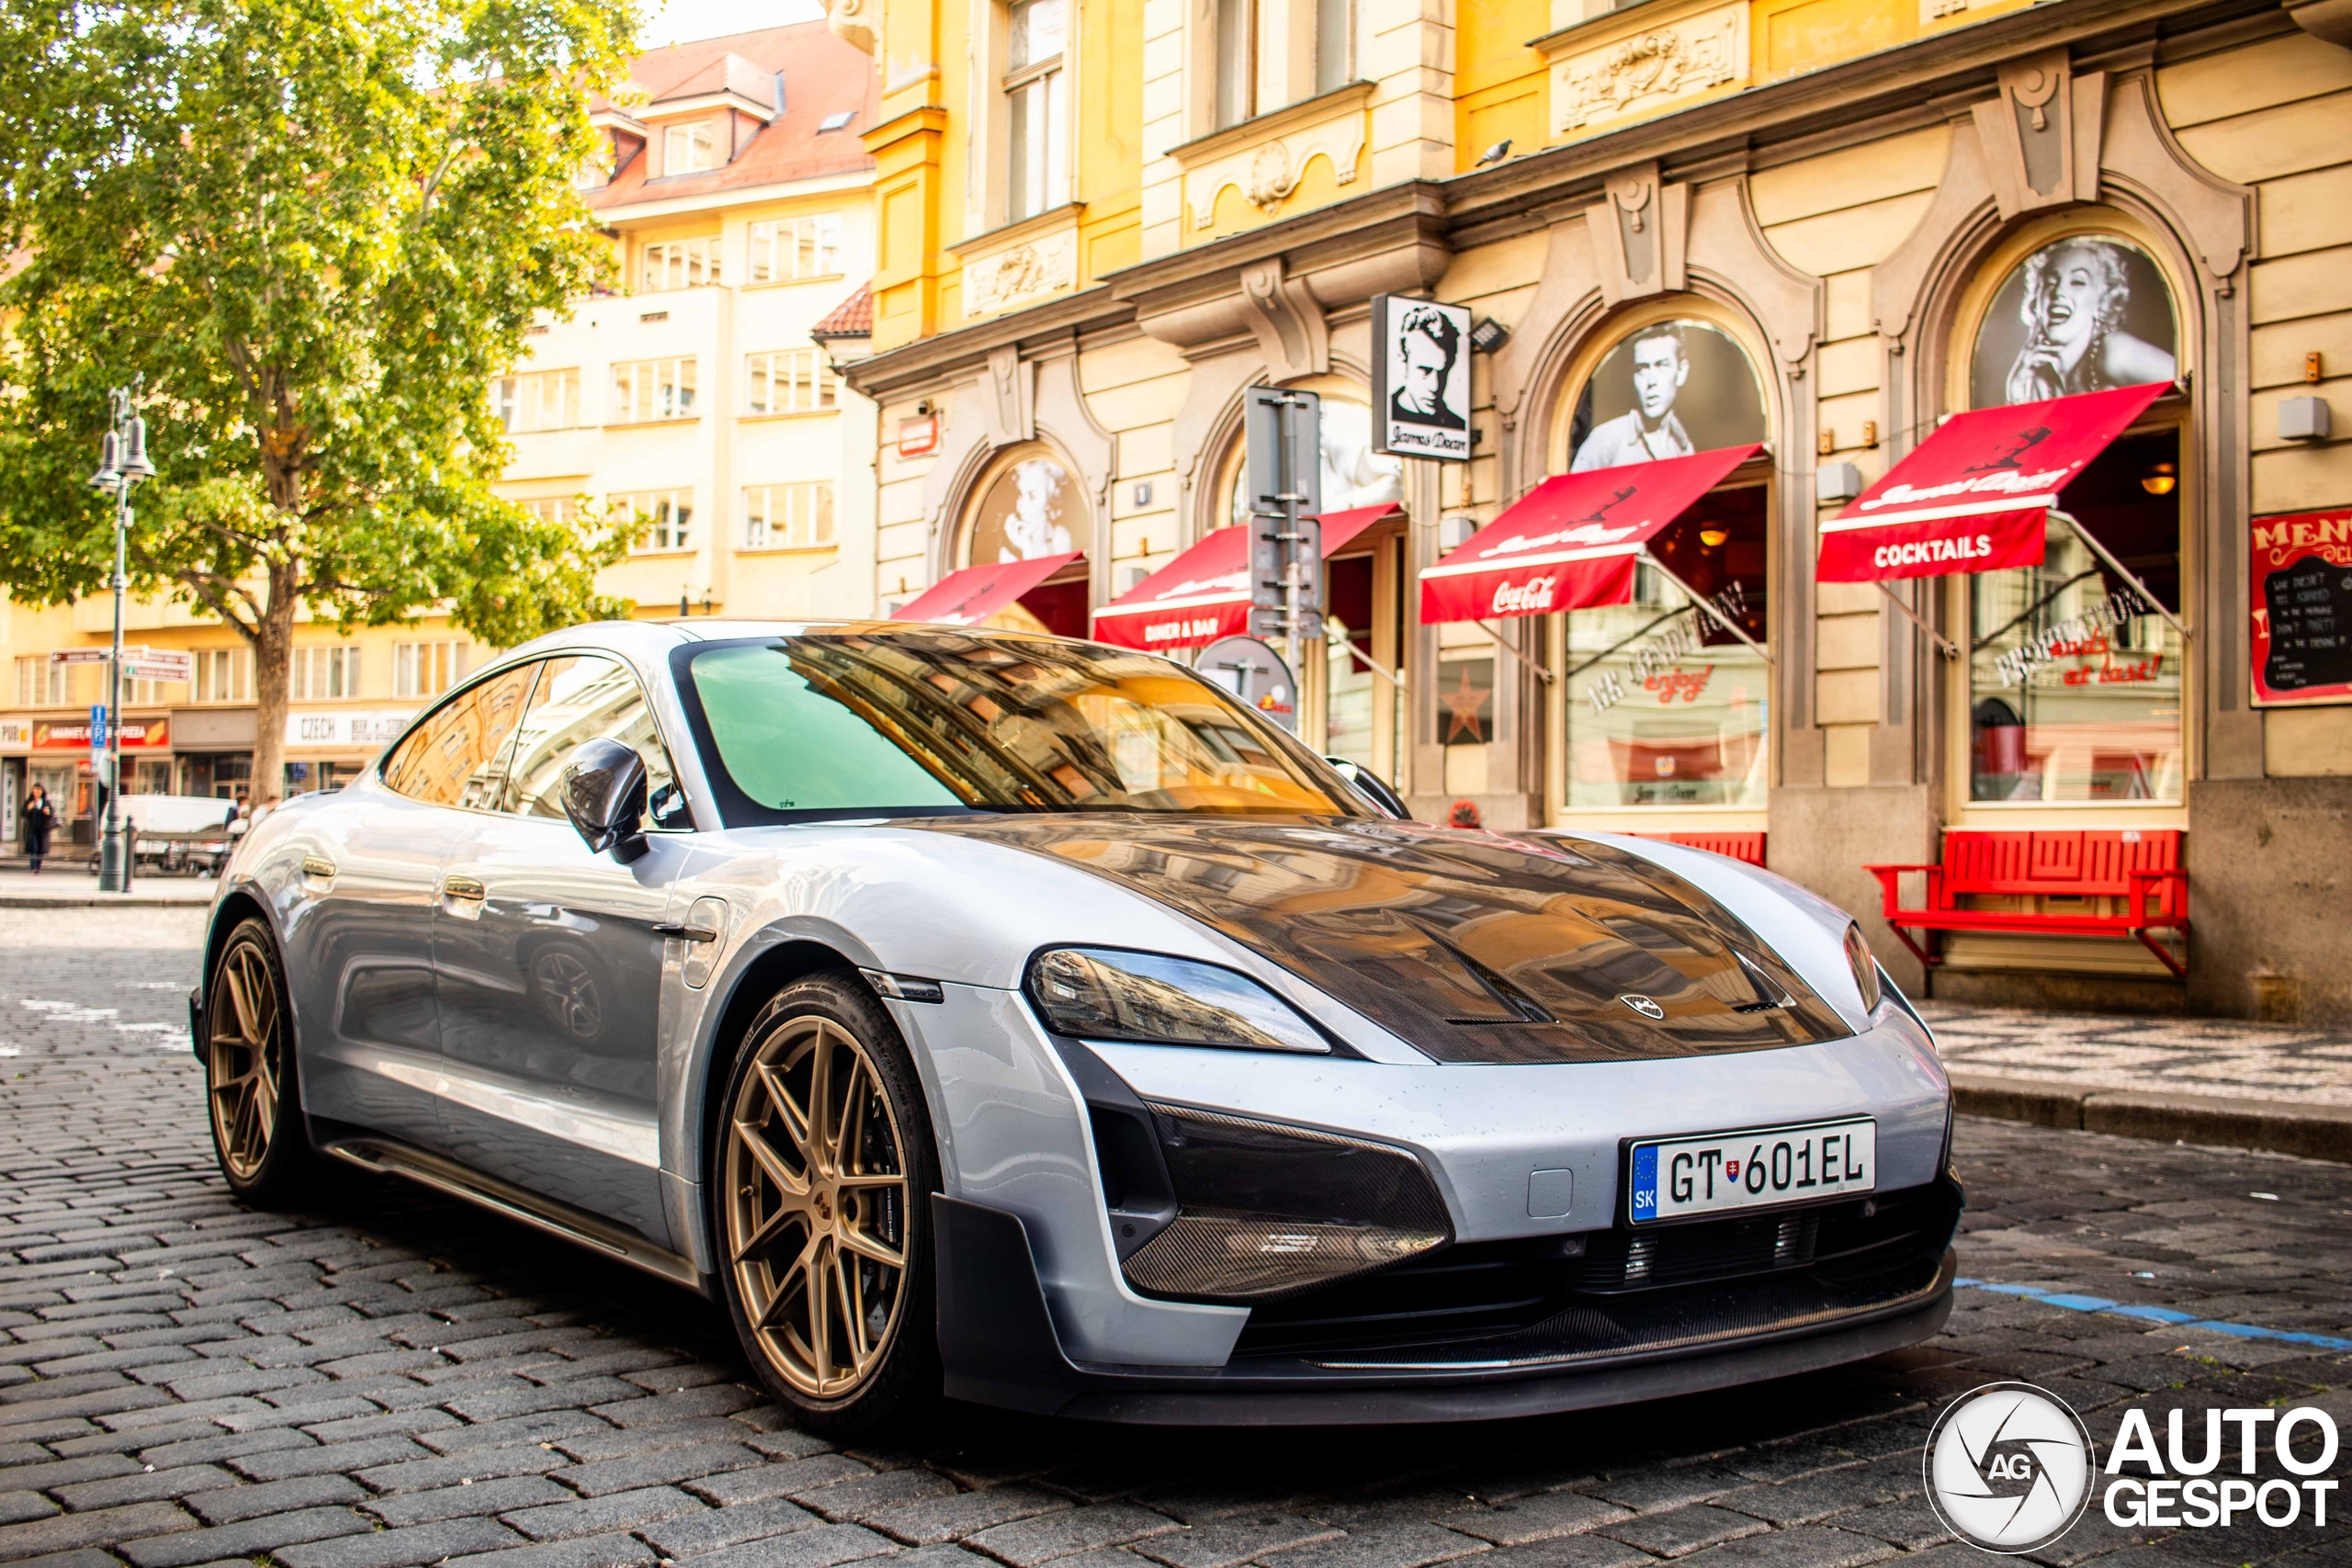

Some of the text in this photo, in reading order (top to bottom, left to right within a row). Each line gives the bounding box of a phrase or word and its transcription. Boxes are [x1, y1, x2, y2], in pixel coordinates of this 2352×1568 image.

[1390, 425, 1466, 451] James Dean
[2253, 517, 2352, 551] MEN
[1874, 534, 1992, 568] COCKTAILS
[1145, 617, 1218, 642] DINER & BAR
[2051, 626, 2109, 658] ends
[1644, 663, 1714, 704] enjoy!
[2064, 654, 2162, 686] at last!
[1670, 1134, 1863, 1203] GT 601EL
[1635, 1189, 1655, 1210] SK
